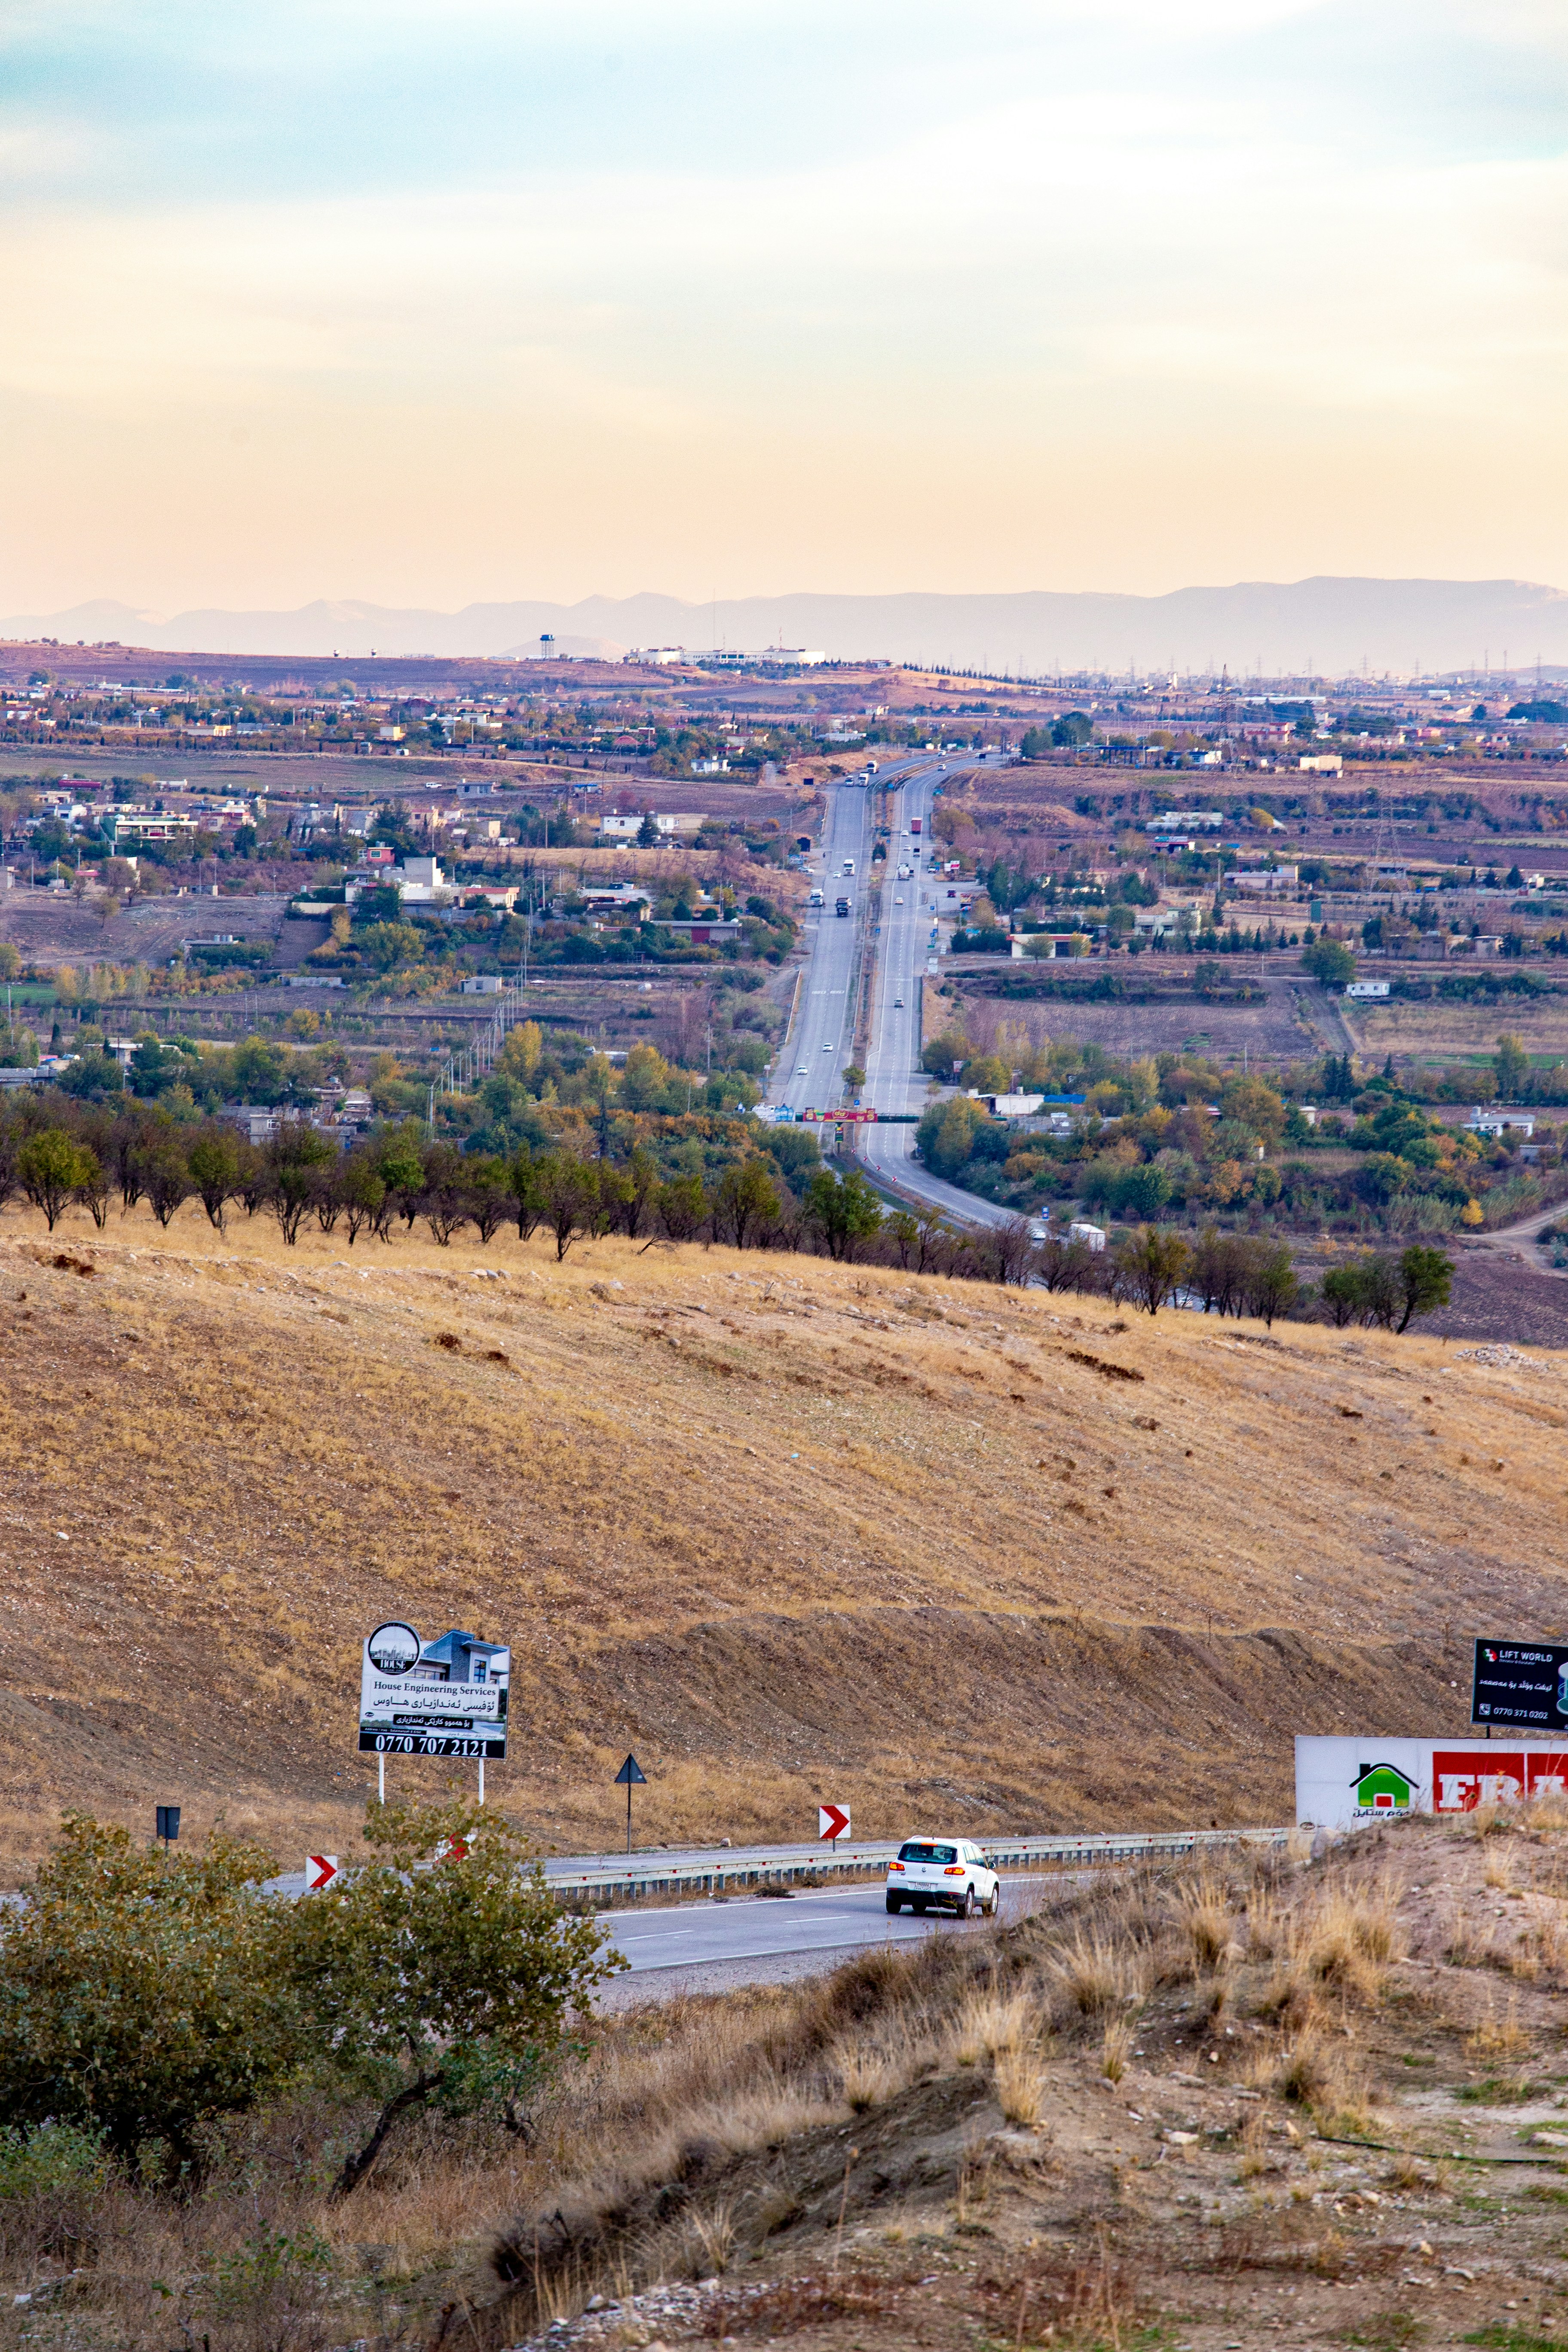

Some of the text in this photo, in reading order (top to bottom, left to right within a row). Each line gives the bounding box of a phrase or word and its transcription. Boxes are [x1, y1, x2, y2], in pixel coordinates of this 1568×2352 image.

[1499, 1650, 1553, 1662] LIFT WORLD
[380, 1659, 406, 1669] HOUSE
[374, 1681, 496, 1696] House Engineering Services
[1493, 1707, 1549, 1719] 0770 371 0202
[375, 1735, 488, 1757] 0770 707 2121
